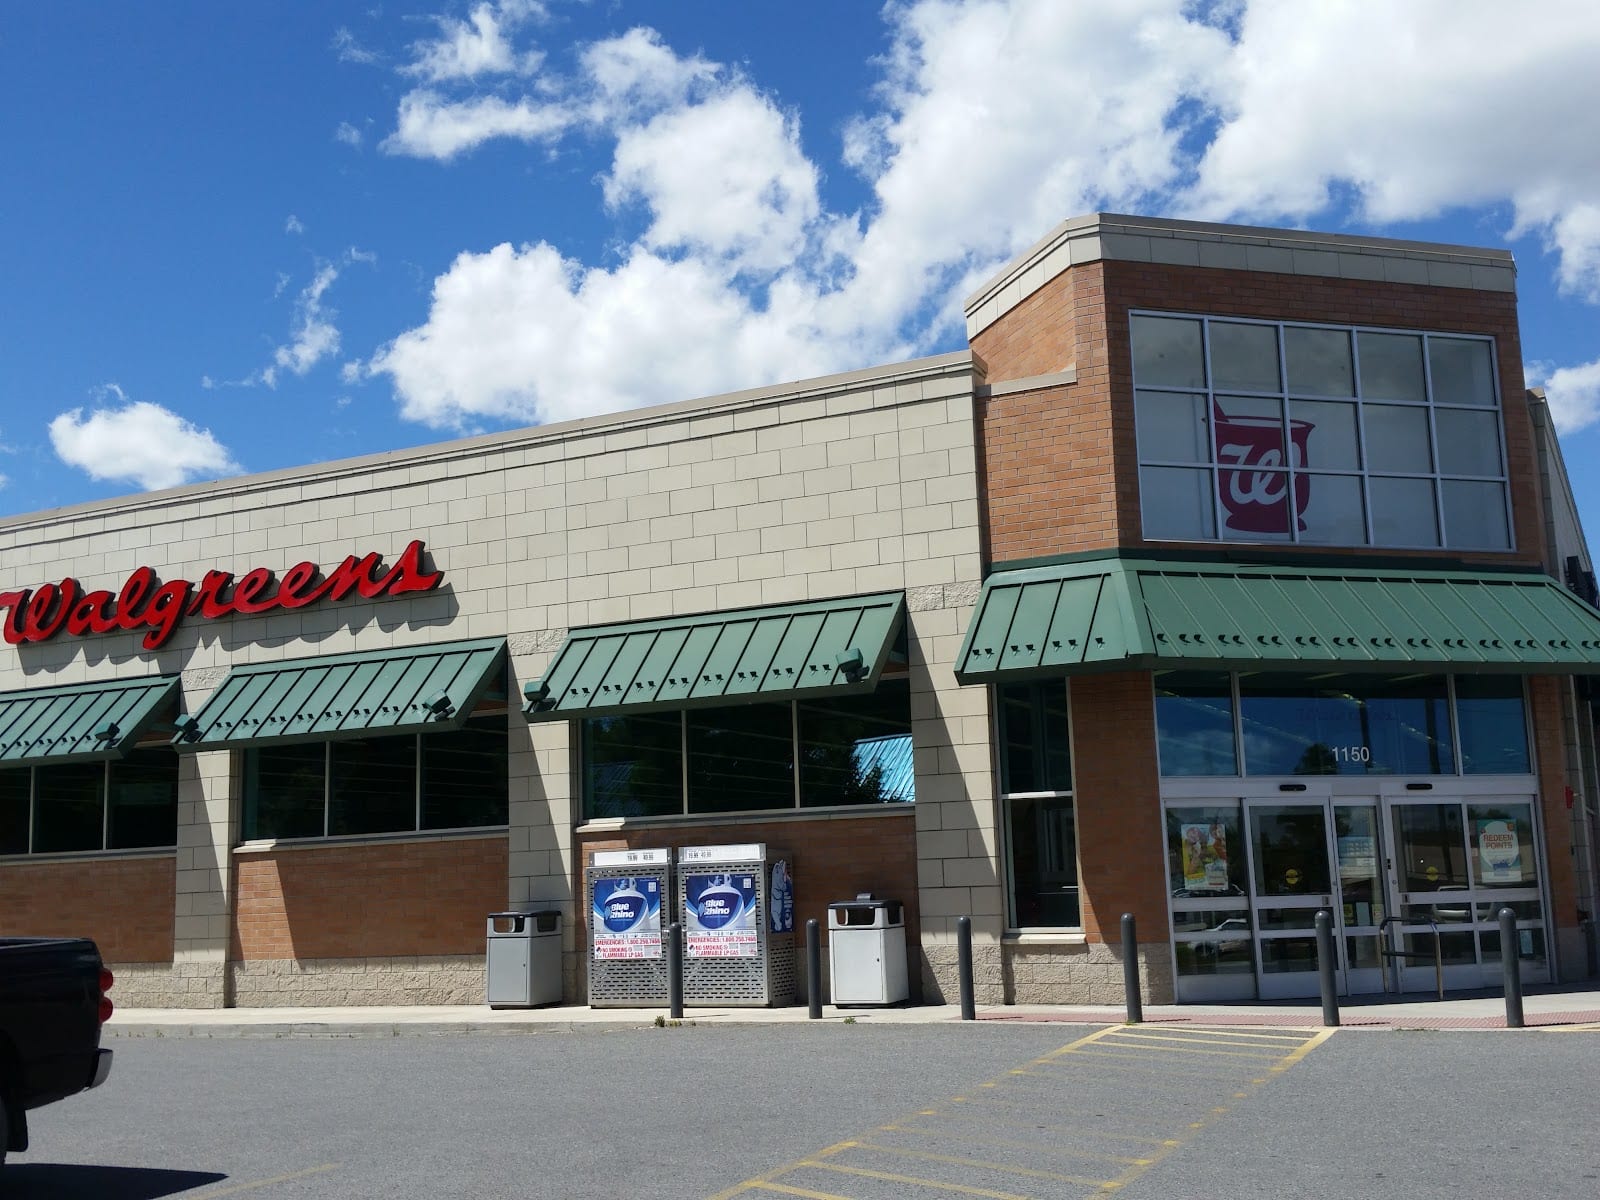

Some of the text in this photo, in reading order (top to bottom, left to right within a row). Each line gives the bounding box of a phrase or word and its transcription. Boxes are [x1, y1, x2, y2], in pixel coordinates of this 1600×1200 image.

[0, 540, 444, 650] Walgreens
[1331, 746, 1370, 762] 1150
[1483, 834, 1514, 842] REDEEM
[1485, 841, 1513, 849] POINTS
[705, 899, 725, 907] Blue
